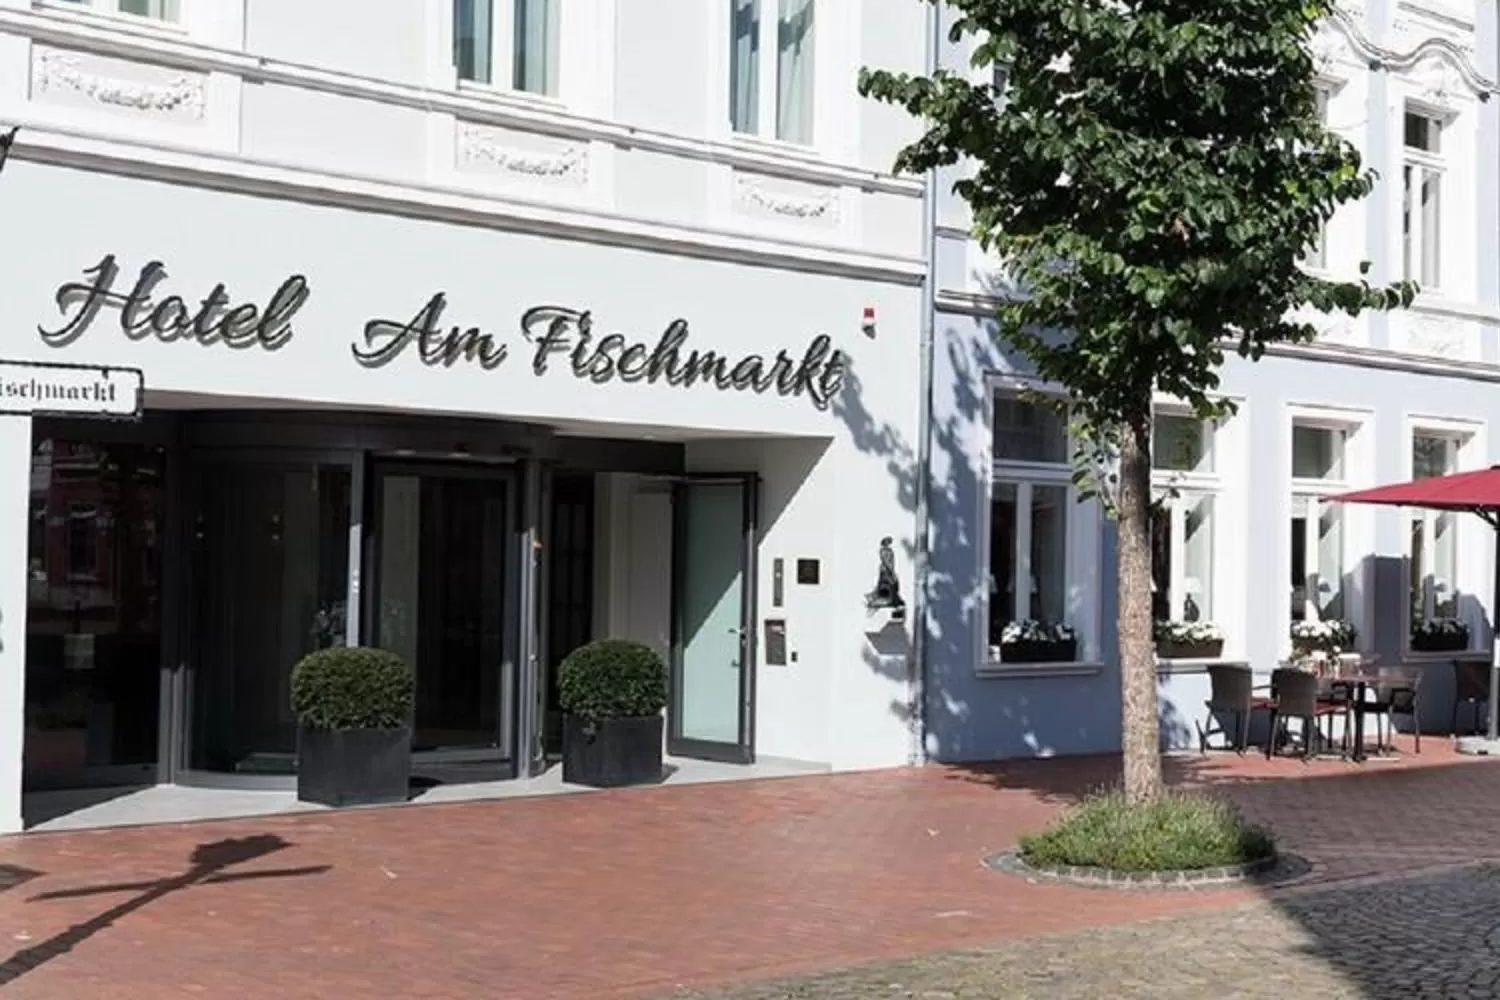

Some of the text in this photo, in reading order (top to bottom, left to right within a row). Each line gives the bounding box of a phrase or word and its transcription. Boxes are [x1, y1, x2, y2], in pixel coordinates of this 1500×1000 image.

[38, 254, 842, 411] Hotel Am Fischmarkt
